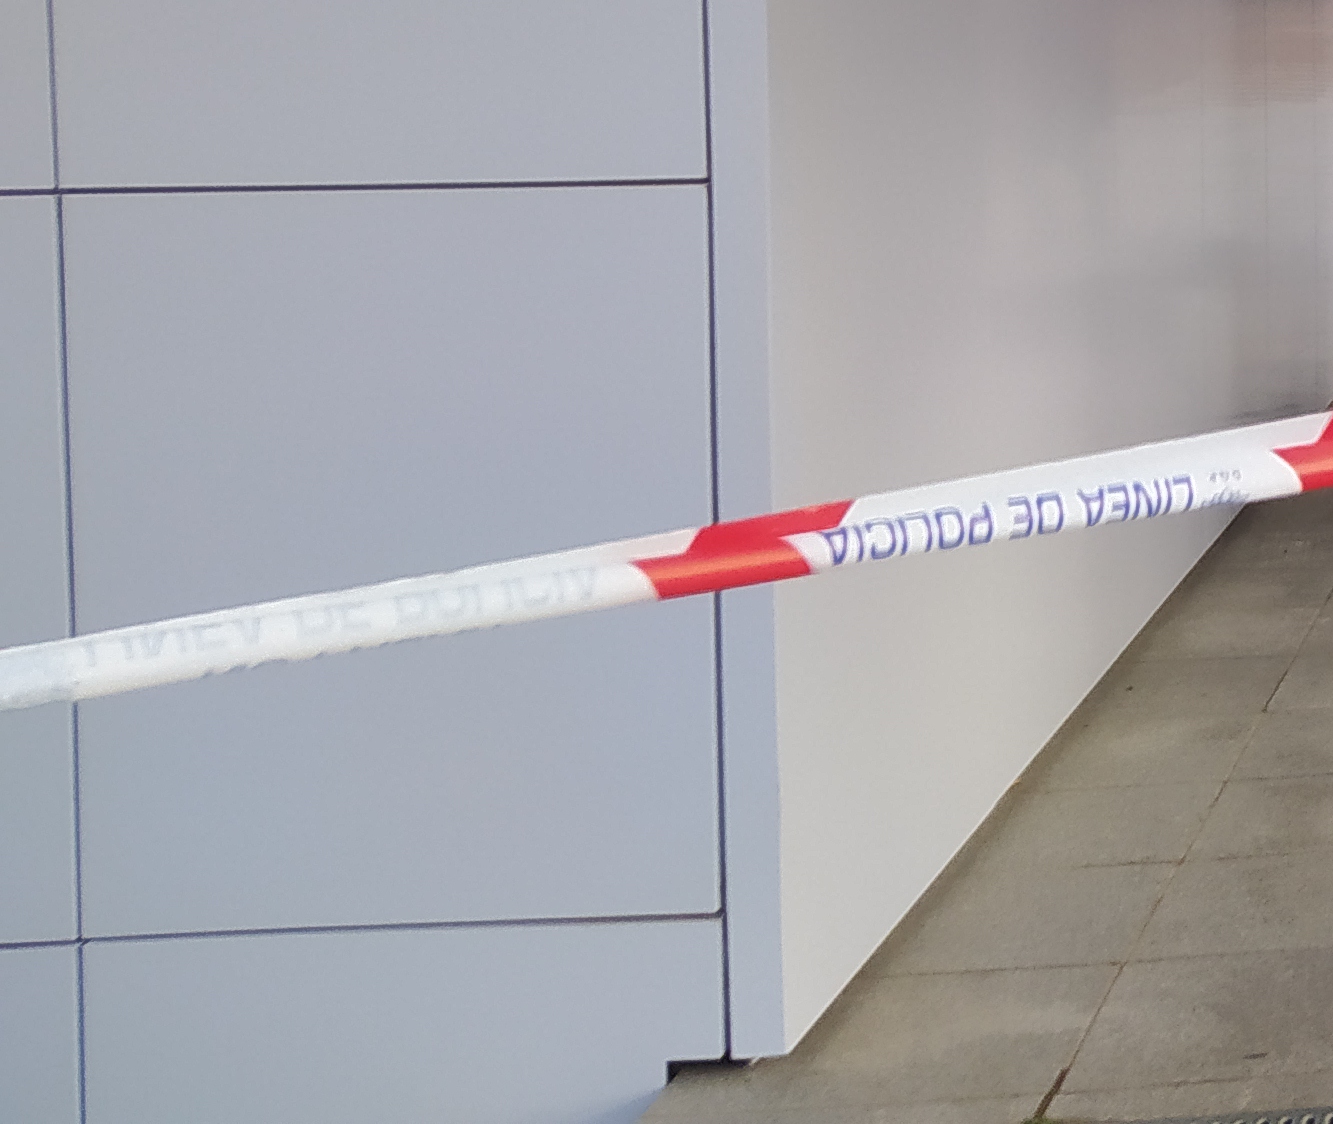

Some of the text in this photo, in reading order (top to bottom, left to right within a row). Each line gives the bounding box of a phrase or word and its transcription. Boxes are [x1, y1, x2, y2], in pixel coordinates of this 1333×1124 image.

[821, 476, 1195, 566] LINEA DE POLICIA
